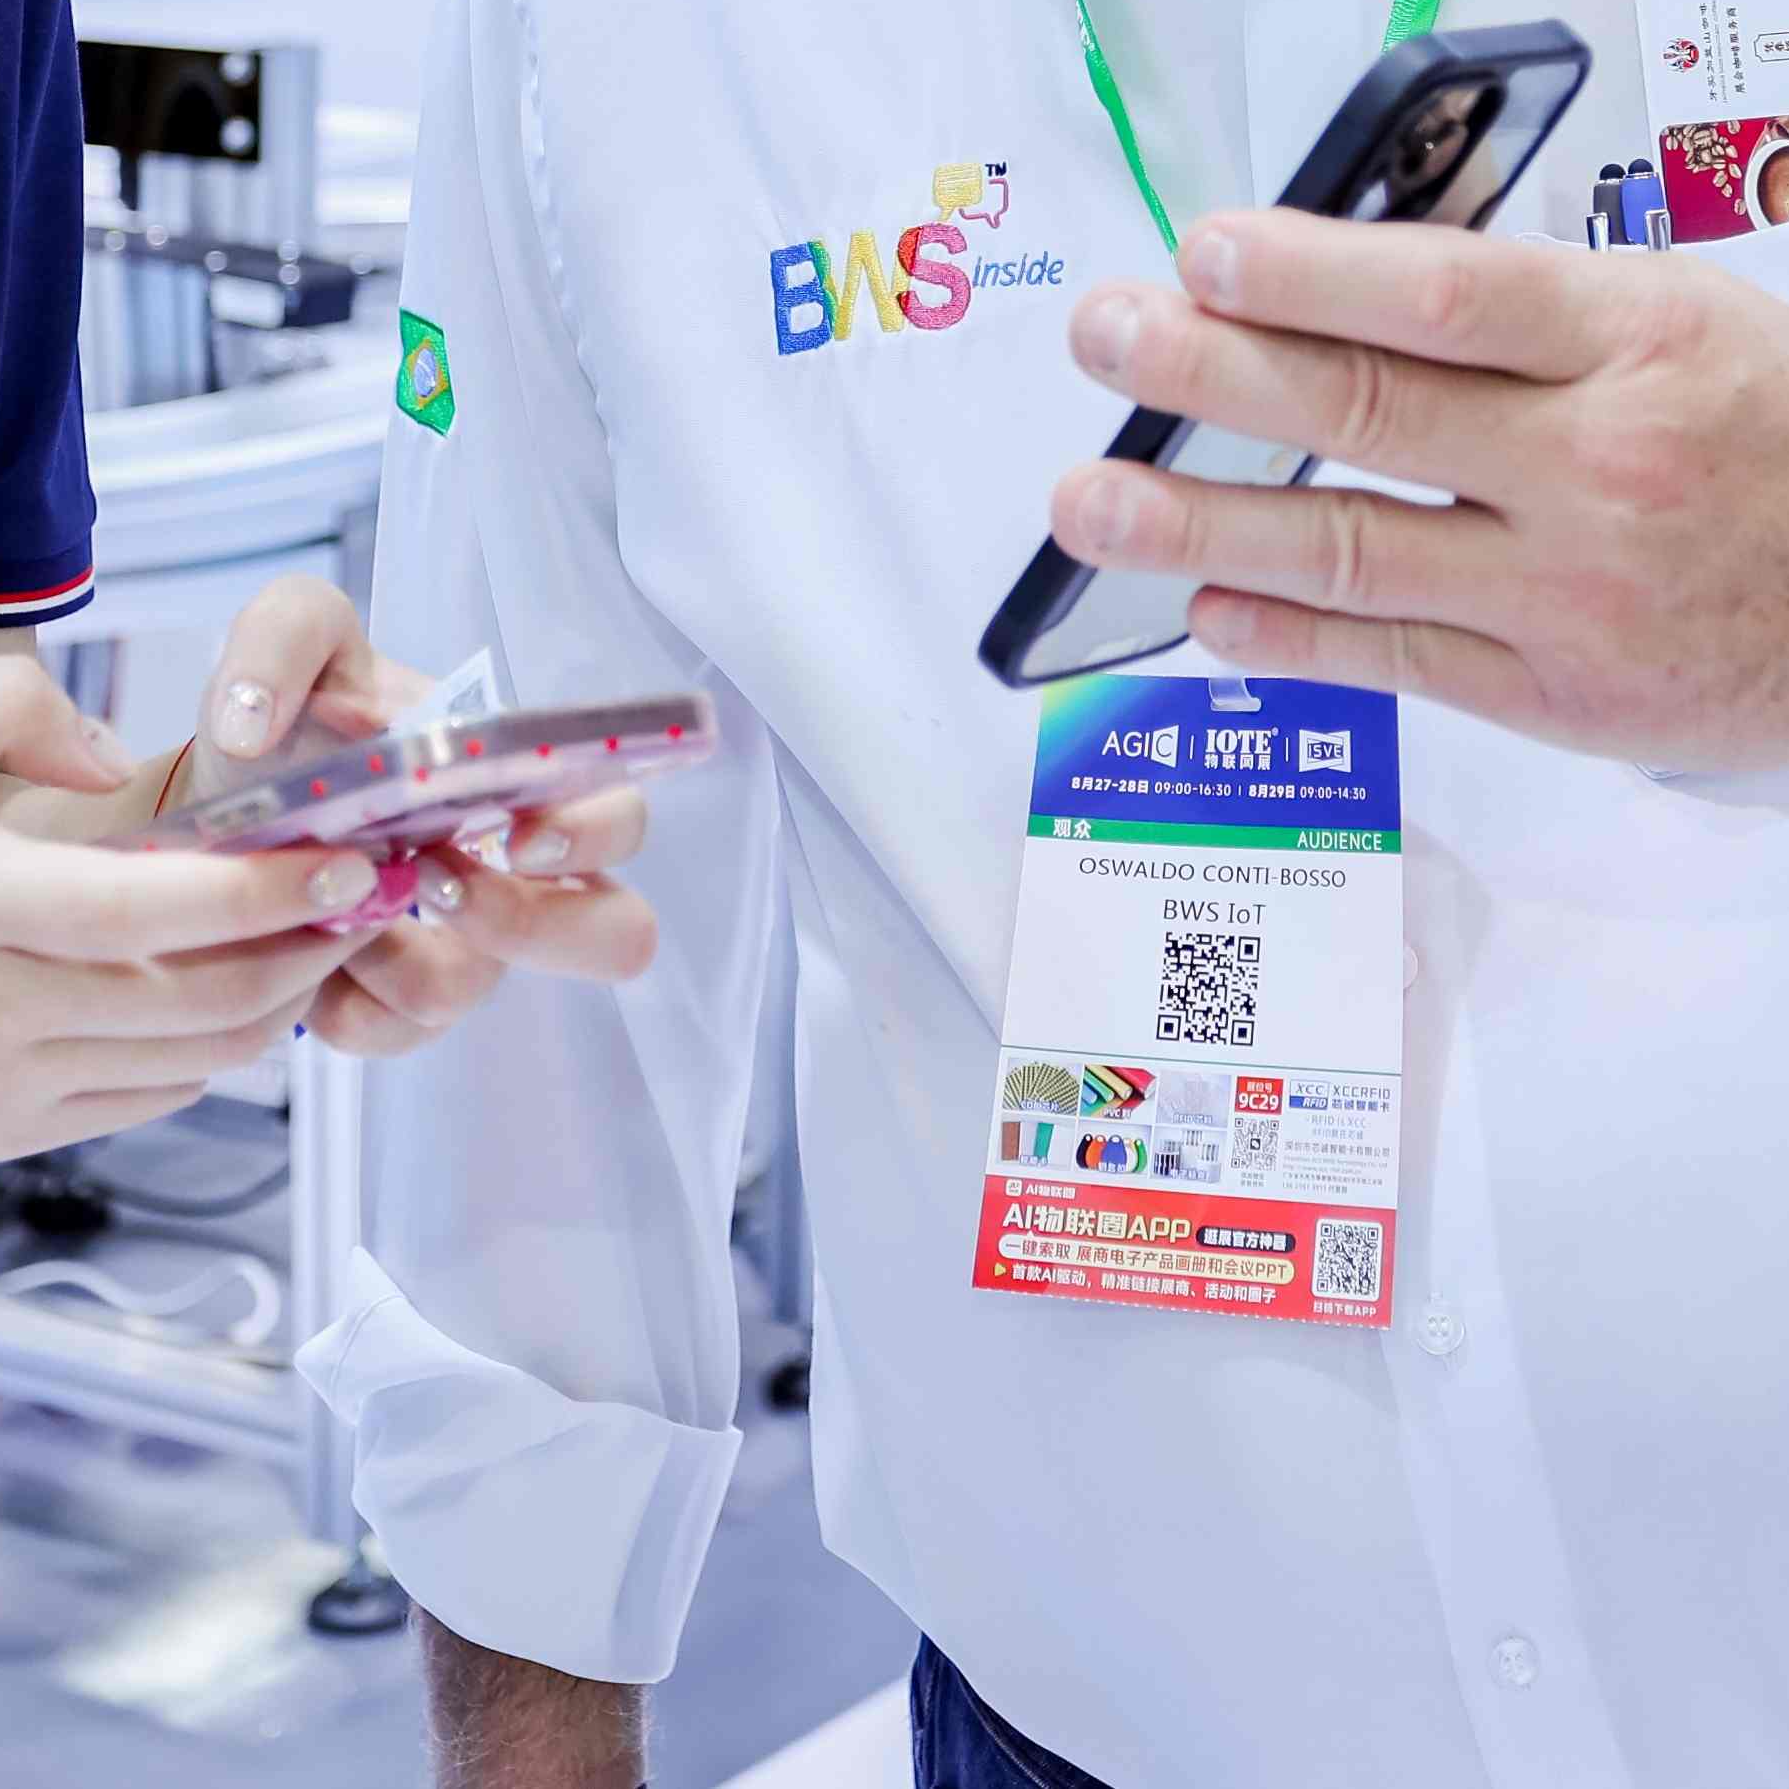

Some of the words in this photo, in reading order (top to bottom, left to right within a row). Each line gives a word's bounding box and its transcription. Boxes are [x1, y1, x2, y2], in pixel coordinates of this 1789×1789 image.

[770, 222, 971, 356] BWS
[973, 251, 1064, 287] inside
[1101, 726, 1179, 765] AGIC
[1206, 729, 1273, 754] IOTE
[1071, 776, 1149, 795] 8月27-28日
[1154, 781, 1231, 797] 09:00-16:30
[1248, 784, 1295, 800] 8月29日
[1299, 786, 1366, 800] 09:00-14:30
[1053, 818, 1092, 839] 观众
[1297, 831, 1383, 852] AUDIENCE
[1079, 856, 1195, 882] OSWALDO
[1203, 864, 1347, 888] CONTI-BOSSO
[1163, 899, 1219, 923] BWS
[1227, 902, 1267, 925] IoT
[1295, 1082, 1325, 1096] XCC
[1332, 1084, 1391, 1101] XCCRFID
[1238, 1093, 1280, 1111] 9C29
[1301, 1097, 1328, 1110] RFID
[1003, 1203, 1192, 1244] AI物联圈APP
[1204, 1228, 1286, 1252] 逛展官方神器
[1005, 1240, 1071, 1258] 一键索取
[1077, 1243, 1287, 1280] 展商电子产品画册和会议PPT
